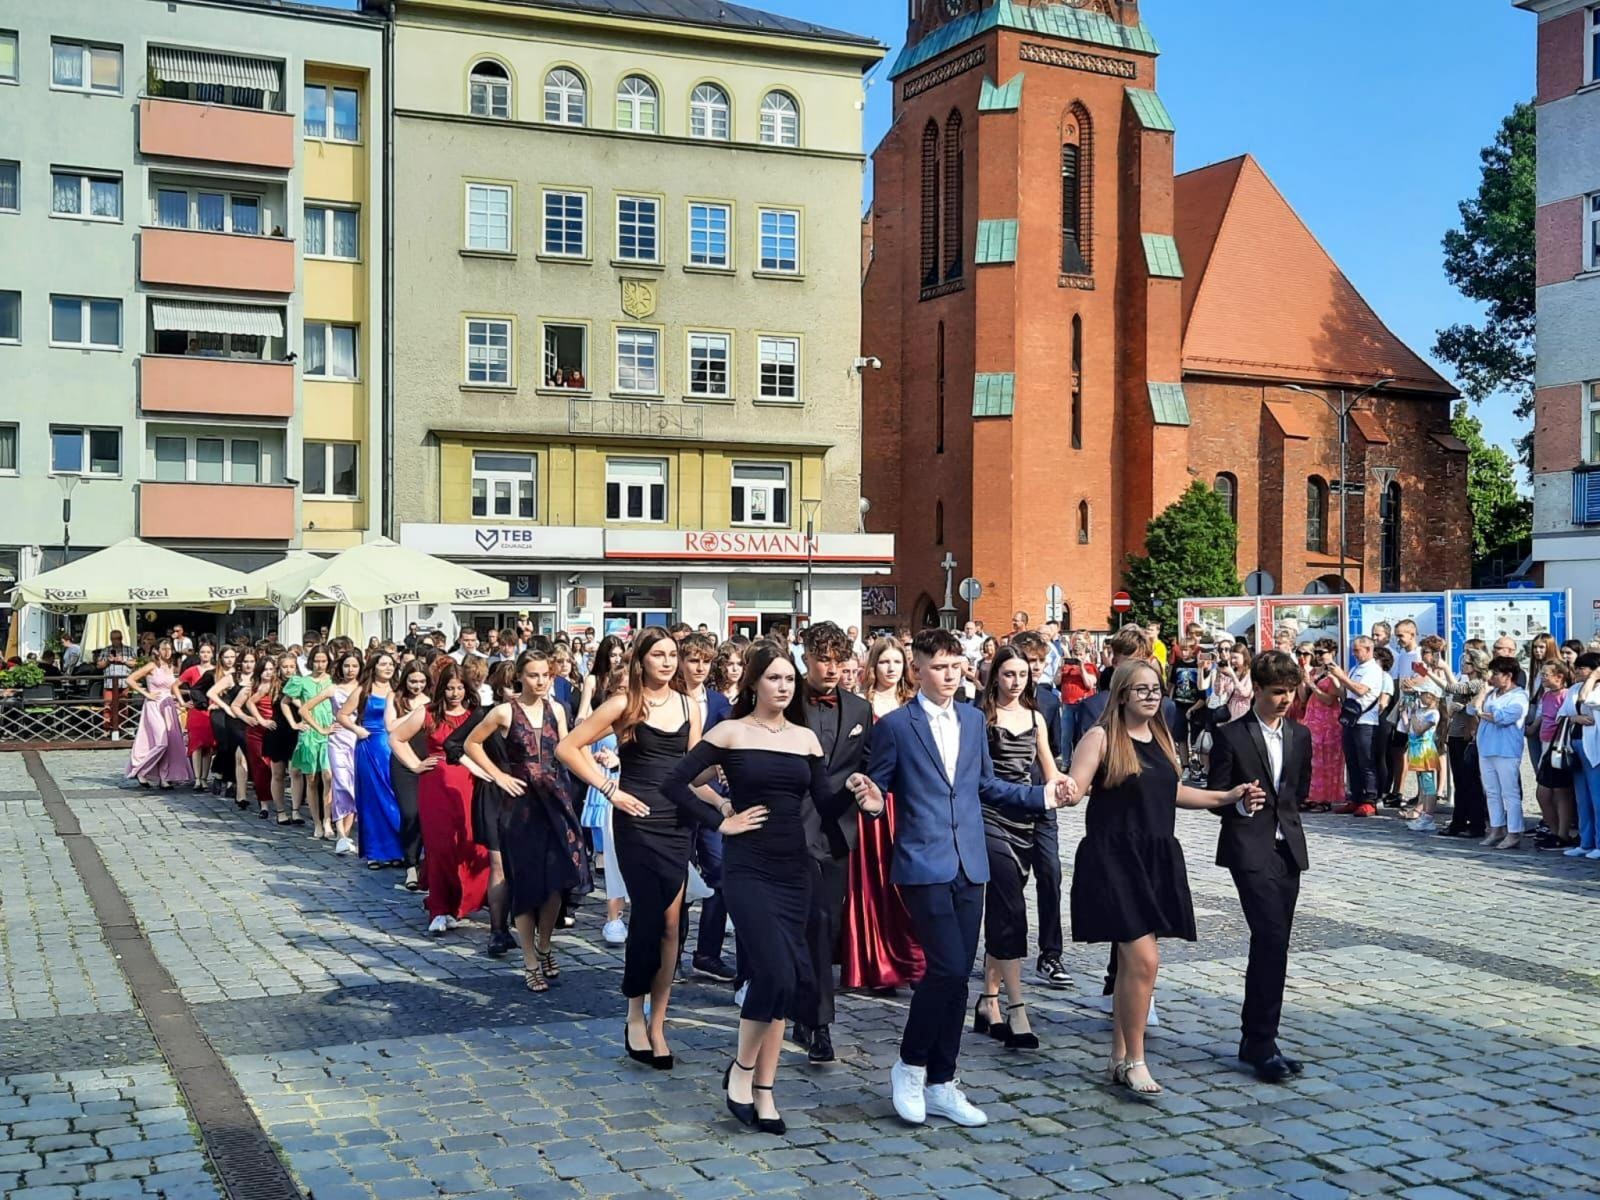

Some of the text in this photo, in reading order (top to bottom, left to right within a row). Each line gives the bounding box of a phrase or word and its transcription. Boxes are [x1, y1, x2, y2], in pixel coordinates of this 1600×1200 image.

[501, 529, 532, 541] TEB
[685, 532, 819, 553] ROSSMANN
[44, 588, 88, 600] Kozel
[128, 587, 169, 600] Kozel
[208, 585, 249, 598] Kozel
[384, 590, 420, 605] Kozel
[455, 586, 491, 599] Kozel
